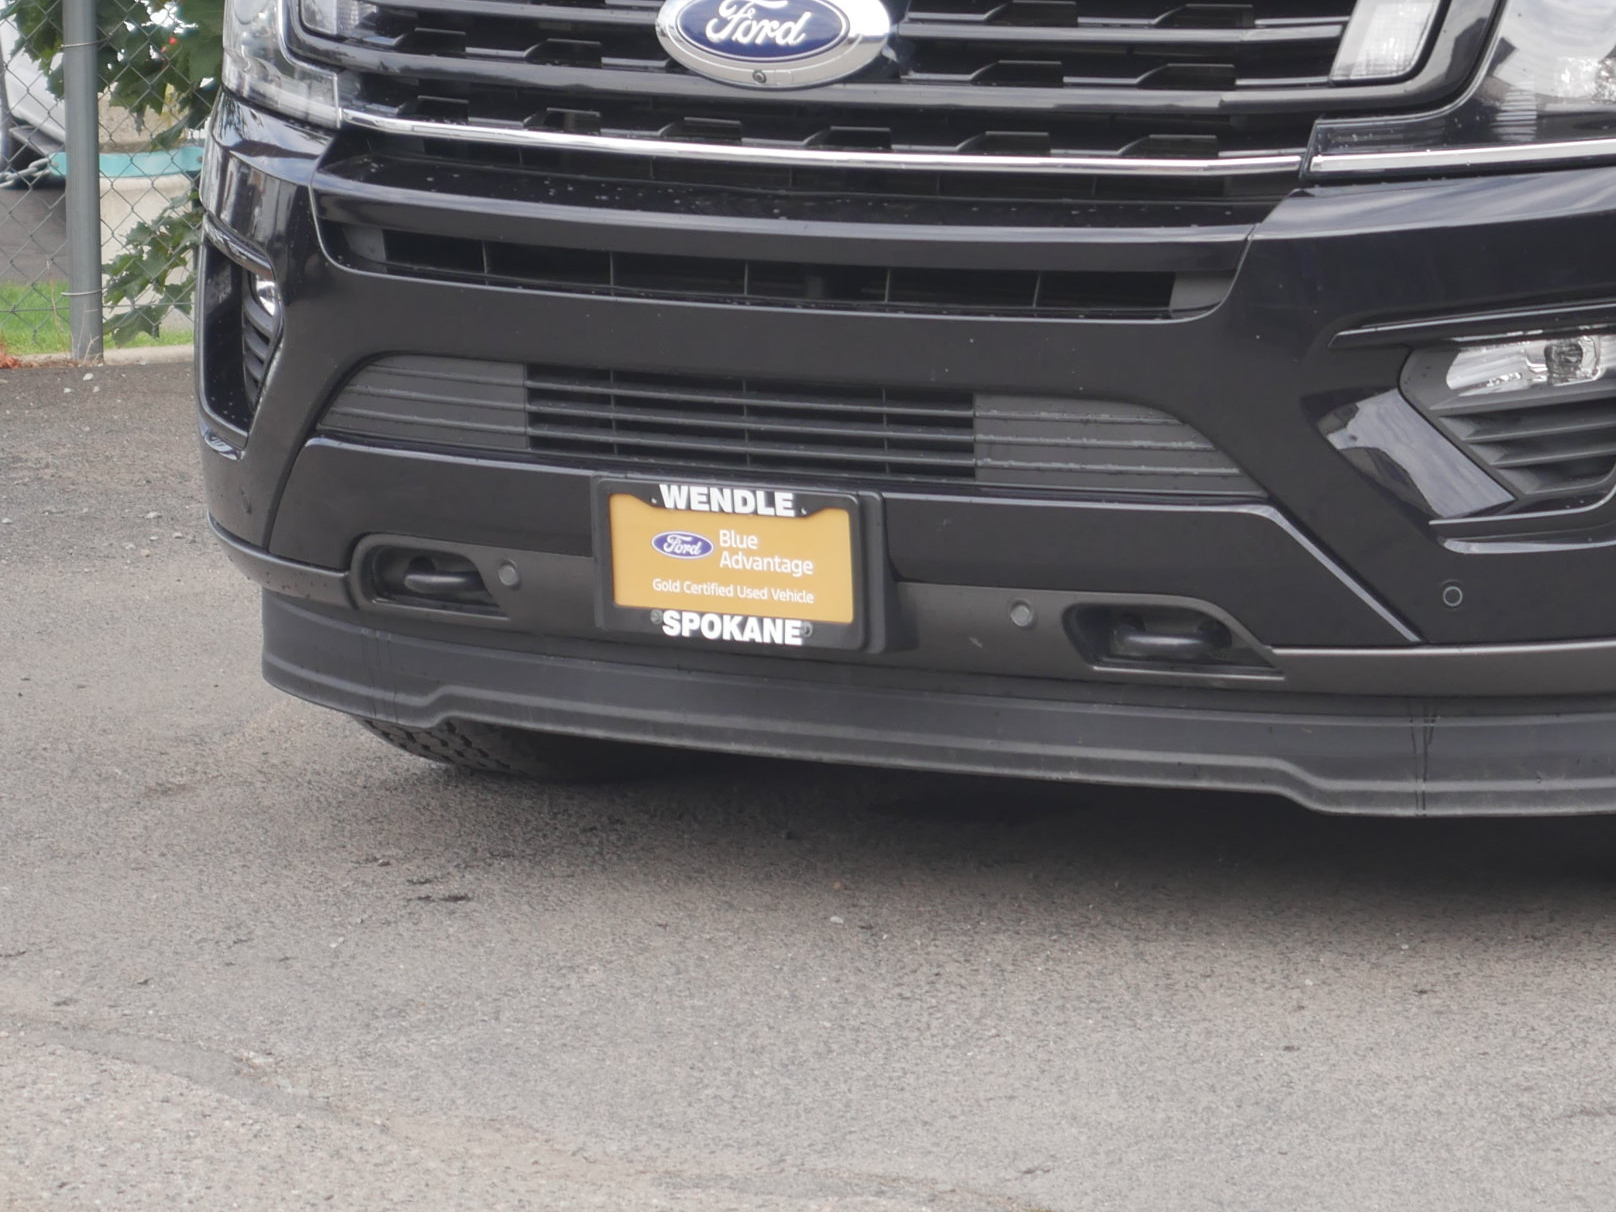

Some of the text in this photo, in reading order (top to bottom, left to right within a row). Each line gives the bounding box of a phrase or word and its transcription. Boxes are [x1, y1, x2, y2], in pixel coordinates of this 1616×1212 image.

[659, 483, 796, 517] WENDLE
[663, 534, 702, 556] Ford
[719, 529, 759, 550] Blue
[719, 551, 814, 577] Advantage
[652, 578, 815, 604] Gold Certified Used Vehicle
[662, 610, 803, 646] SPOKANE
